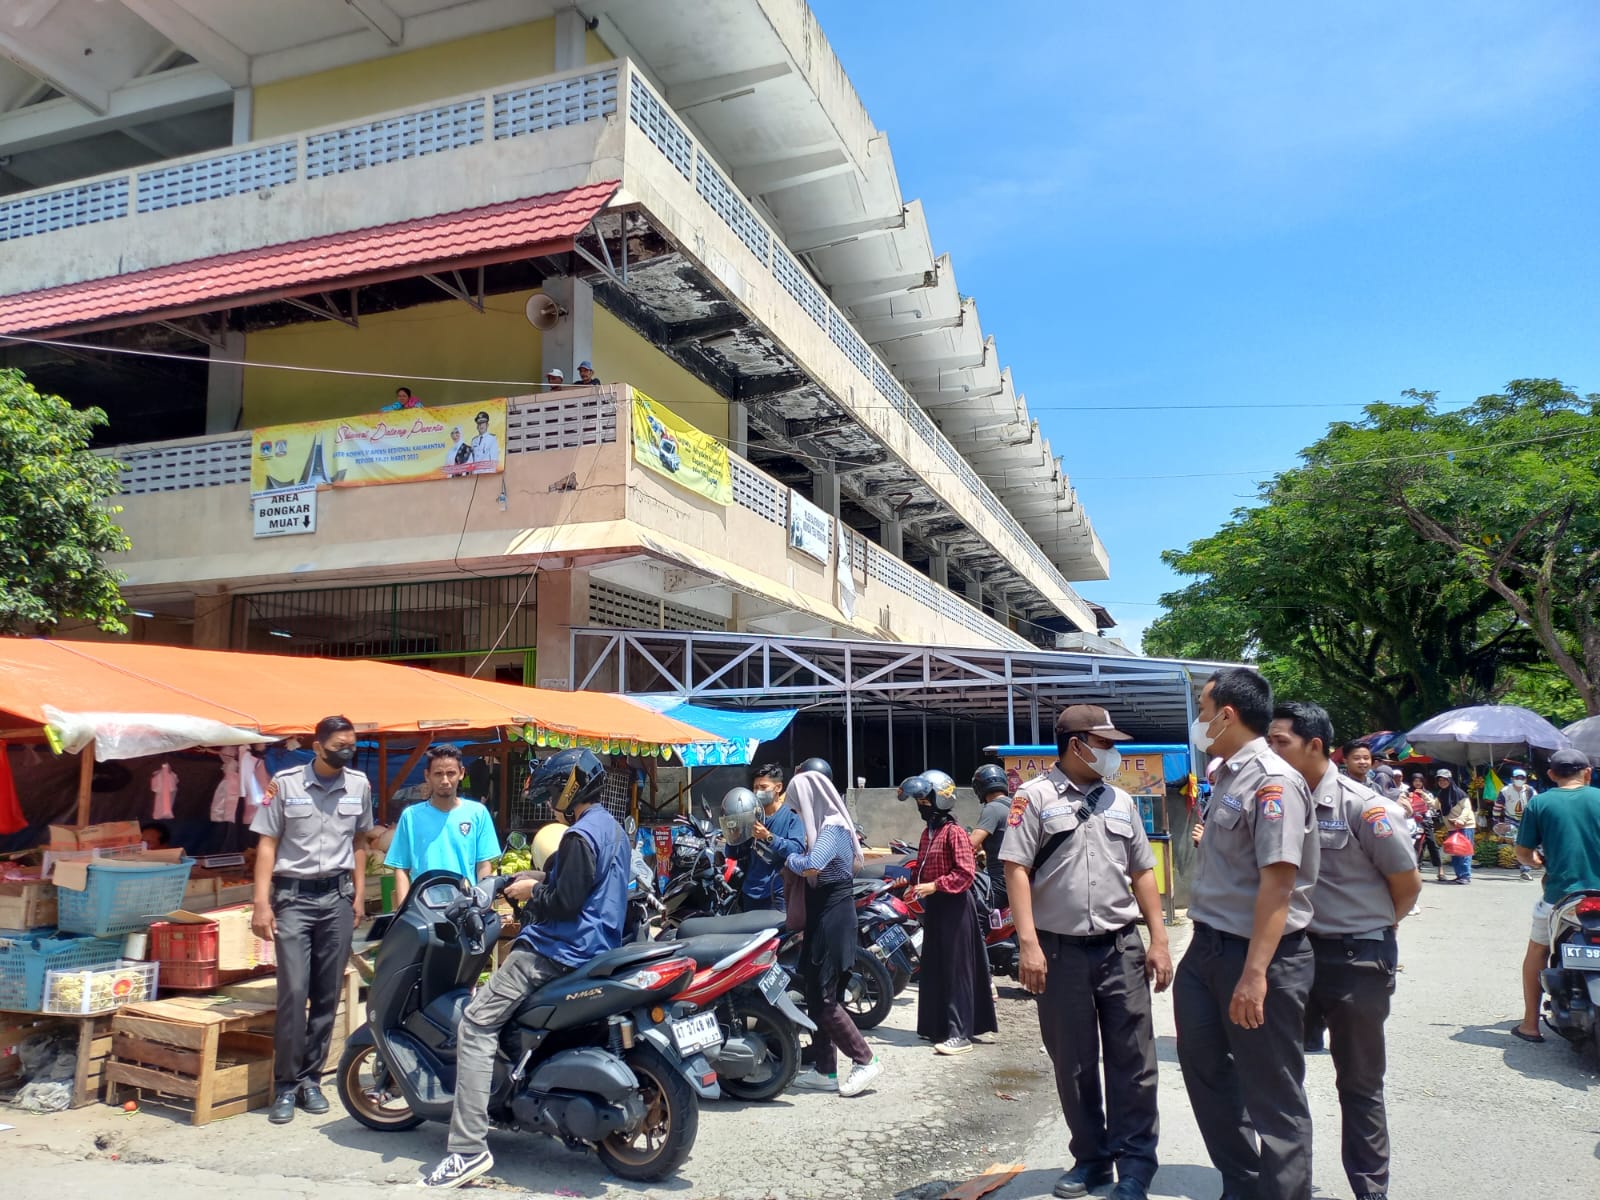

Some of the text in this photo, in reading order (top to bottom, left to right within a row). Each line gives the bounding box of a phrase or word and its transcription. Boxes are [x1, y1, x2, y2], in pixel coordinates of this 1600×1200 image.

[271, 493, 299, 504] AREA
[259, 504, 310, 517] BONGKAR
[269, 517, 299, 528] MUAT
[1014, 759, 1146, 771] JAL TE
[1567, 947, 1581, 957] KT
[675, 1026, 686, 1039] KT
